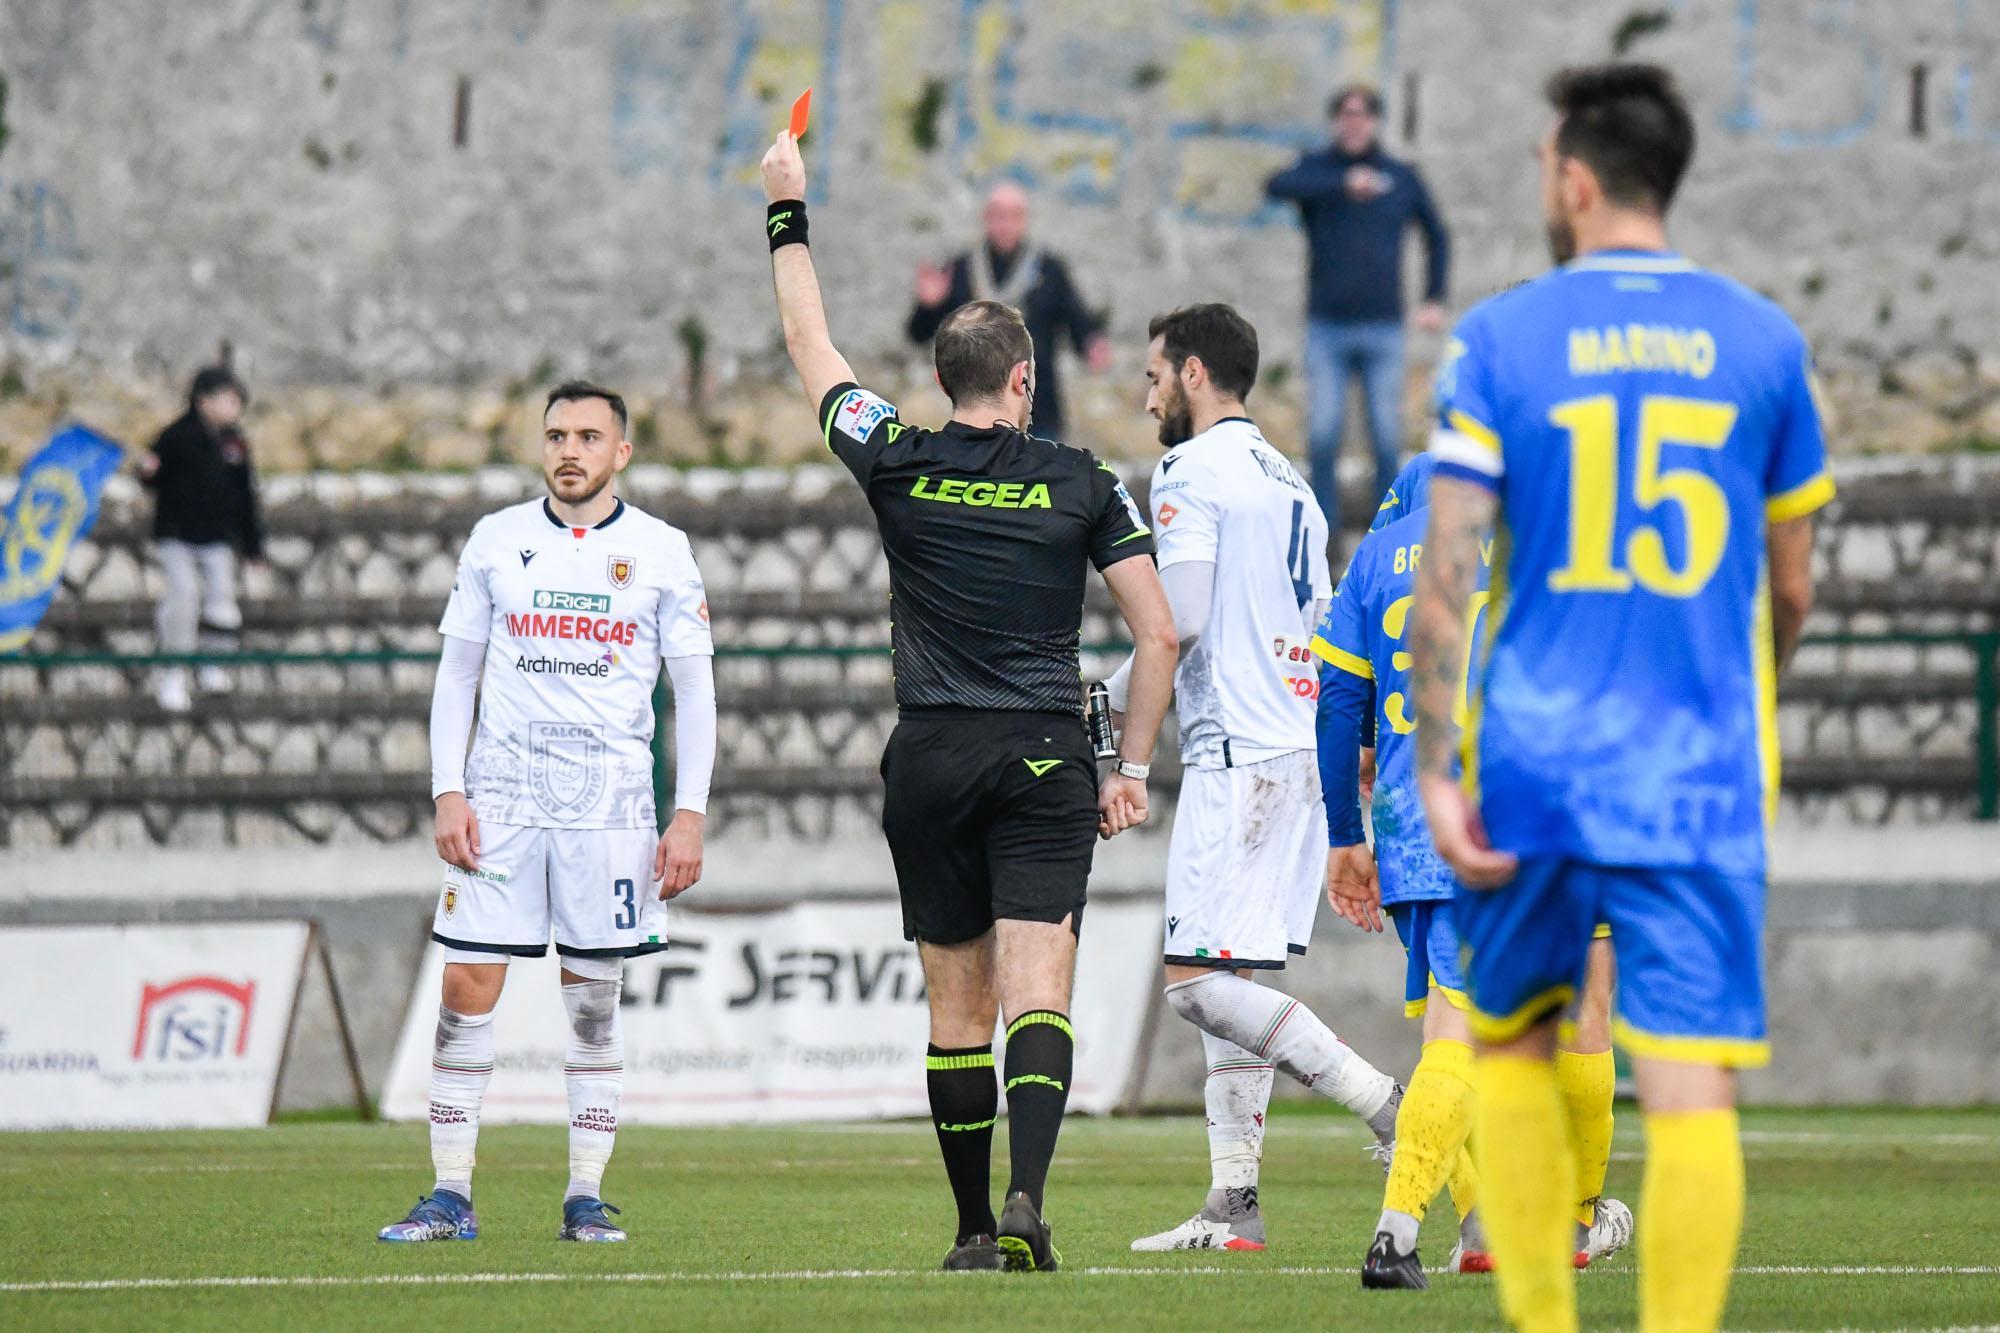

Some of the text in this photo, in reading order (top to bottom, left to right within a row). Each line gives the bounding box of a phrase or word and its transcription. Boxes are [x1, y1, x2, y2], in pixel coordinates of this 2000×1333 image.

[1567, 324, 1718, 380] MARINO
[909, 476, 1052, 509] LEGEA
[1548, 393, 1741, 600] 15
[1287, 499, 1313, 612] 4
[552, 592, 608, 612] RIGHI
[506, 612, 639, 646] IMMERGAS
[515, 655, 609, 677] Archimede
[540, 726, 594, 738] CALCIO
[614, 878, 636, 930] 3
[728, 943, 928, 1009] SERVI
[157, 1004, 229, 1062] fsi
[577, 1114, 616, 1124] CALCIO
